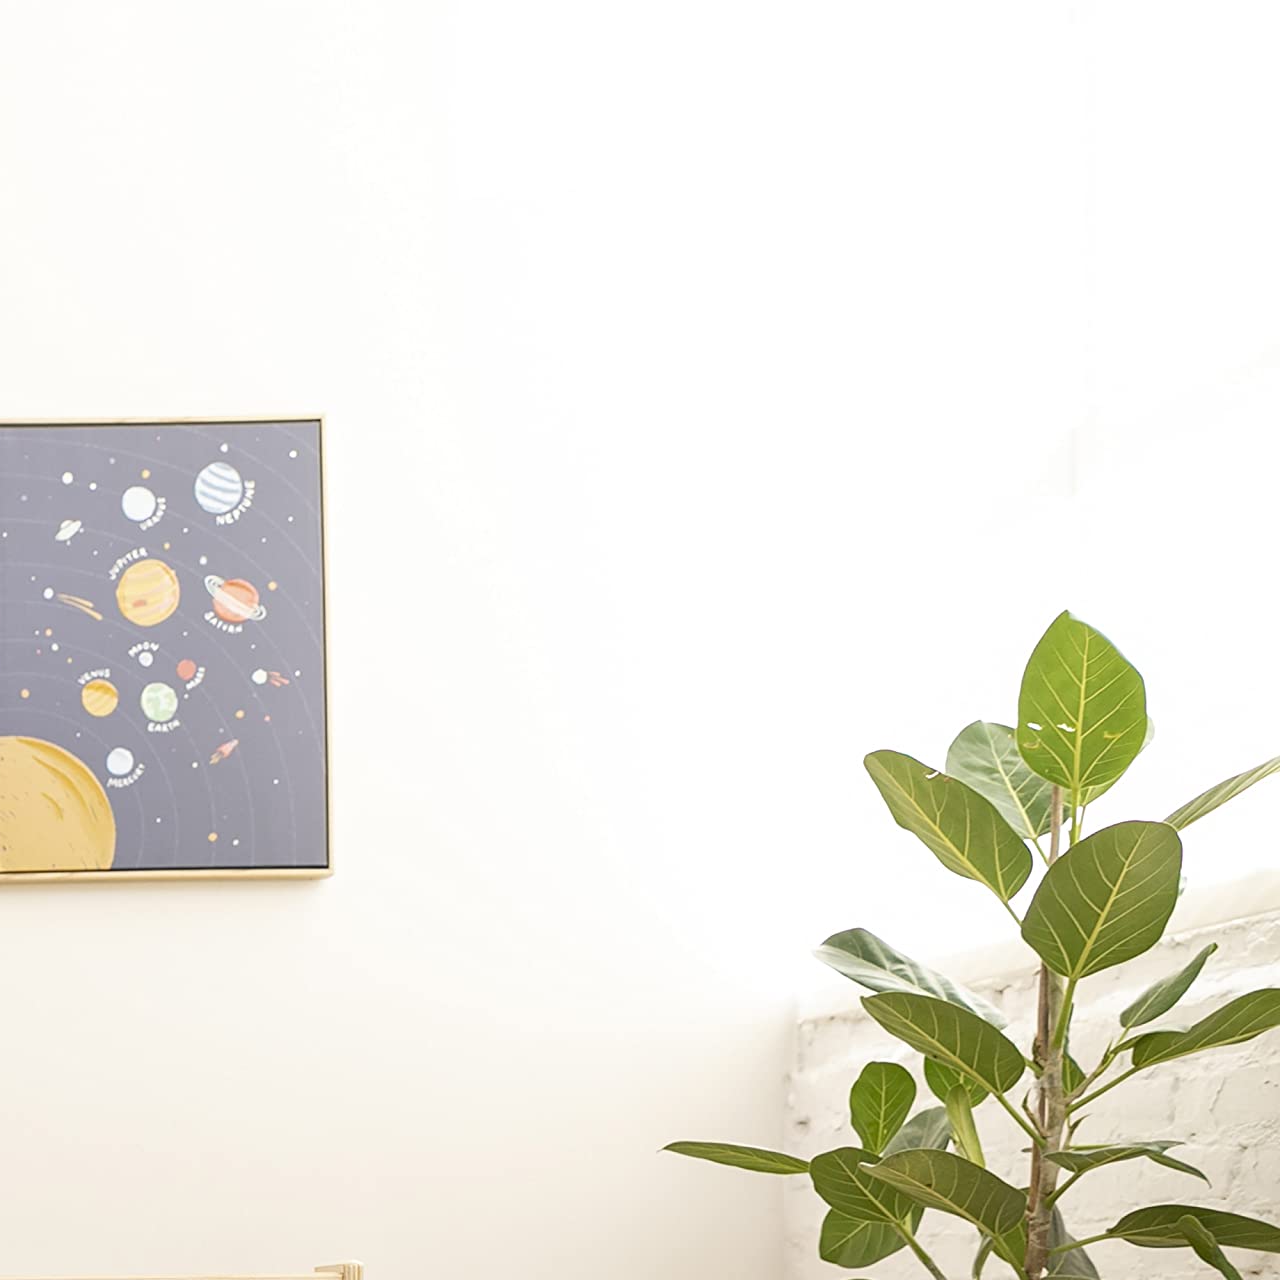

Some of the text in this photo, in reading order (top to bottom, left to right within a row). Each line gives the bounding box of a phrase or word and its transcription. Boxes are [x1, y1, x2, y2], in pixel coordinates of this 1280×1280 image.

[216, 480, 255, 526] NEPTUNE
[108, 547, 148, 580] JUPITER
[78, 668, 110, 685] VENUS
[147, 719, 180, 732] EARTH
[106, 763, 145, 788] MERCURY
